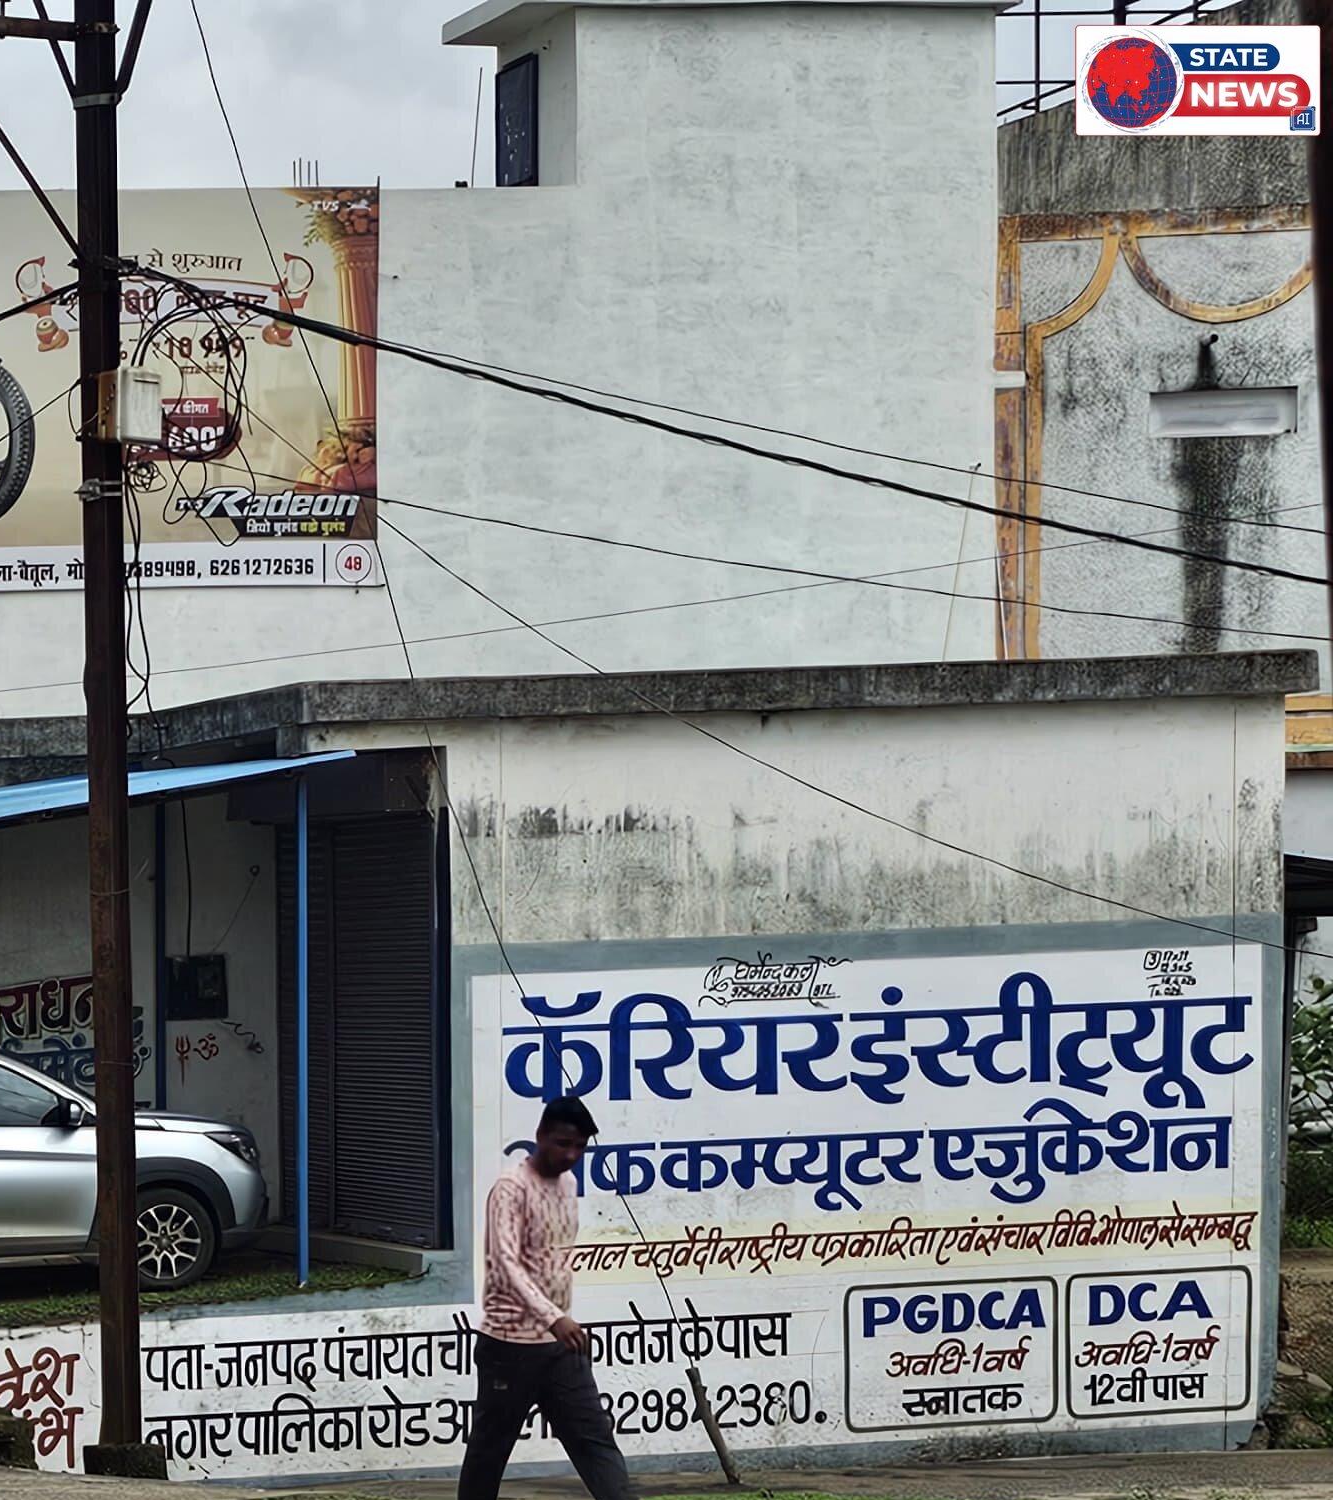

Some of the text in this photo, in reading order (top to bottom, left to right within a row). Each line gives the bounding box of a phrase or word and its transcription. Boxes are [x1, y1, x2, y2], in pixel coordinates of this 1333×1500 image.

[312, 201, 339, 212] TVS
[145, 248, 163, 268] से
[200, 486, 360, 518] Radeon
[209, 558, 315, 577] 6261272636
[344, 555, 363, 572] 48
[659, 1123, 922, 1212] कम्प्यूटर
[928, 1097, 1233, 1204] एजुकेशन
[811, 1216, 940, 1267] पत्रकारिता
[862, 1288, 1046, 1338] PGDCA
[1088, 1280, 1213, 1327] DCA
[321, 1326, 435, 1384] पंचायत
[713, 1311, 792, 1361] पास
[901, 1382, 1024, 1418] स्नातक
[1144, 1372, 1209, 1402] पास
[144, 1412, 234, 1461] नगर
[236, 1392, 366, 1457] पालिका
[368, 1385, 433, 1448] रोड
